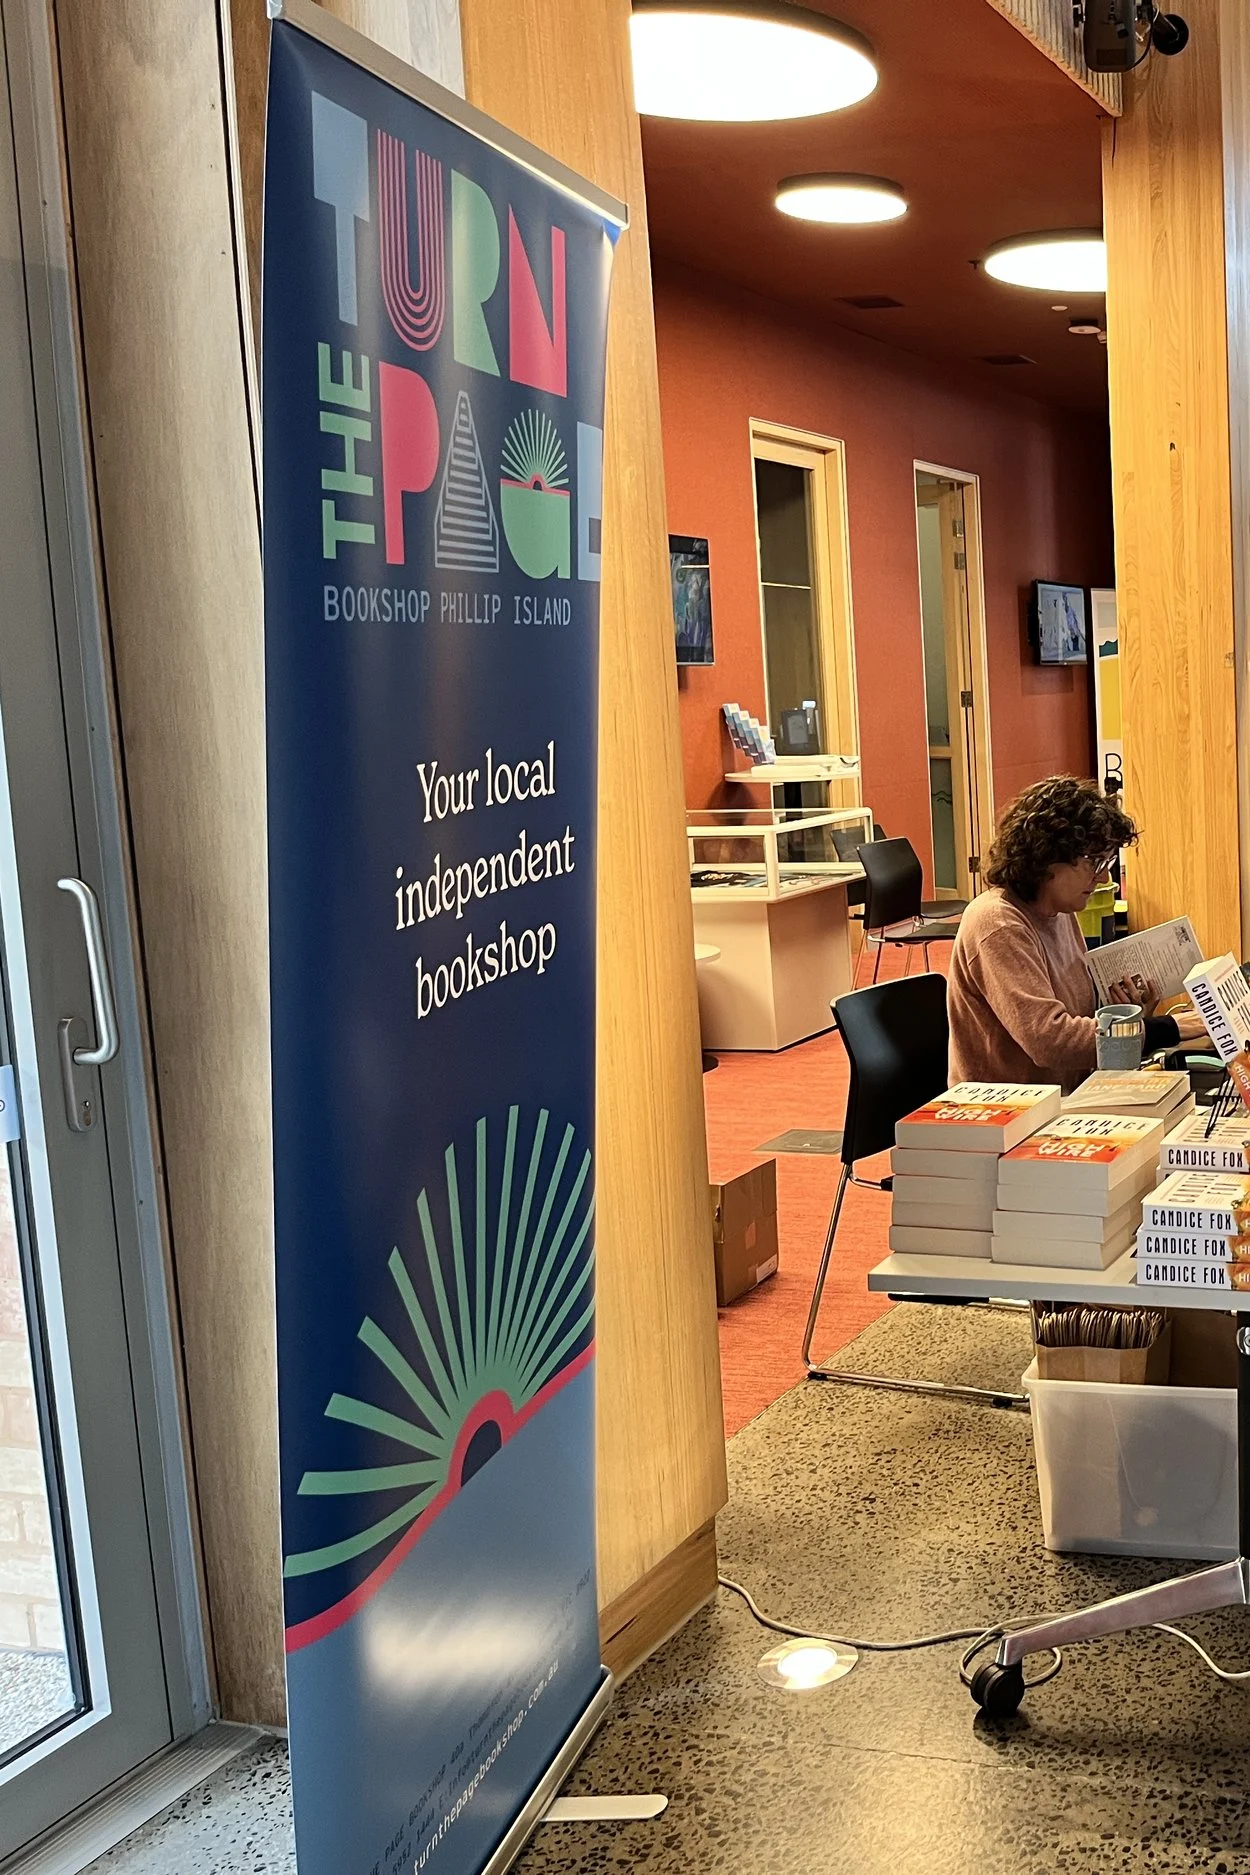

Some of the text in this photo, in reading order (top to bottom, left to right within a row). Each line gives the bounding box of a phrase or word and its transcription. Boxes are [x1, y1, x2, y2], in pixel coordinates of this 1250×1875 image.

[311, 91, 566, 397] TURN
[318, 342, 376, 559] THE
[379, 361, 603, 582] PAGE
[323, 584, 571, 626] BOOKSHOP PHILLIP ISLAND
[416, 740, 555, 823] Your local
[395, 825, 575, 930] independent
[415, 920, 556, 1019] bookshop
[1191, 983, 1240, 1057] CANDICE FOX
[954, 1085, 1049, 1098] CANDICE
[1056, 1117, 1150, 1131] CANDICE
[1168, 1149, 1216, 1167] CANDICE
[1223, 1151, 1243, 1168] FOX
[1146, 1236, 1197, 1255] CANDICE
[1205, 1238, 1226, 1257] FOX
[1152, 1209, 1203, 1229] CANDICE
[1210, 1212, 1232, 1231] FOX
[1146, 1264, 1196, 1283] CANDICE
[1203, 1266, 1225, 1285] FOX
